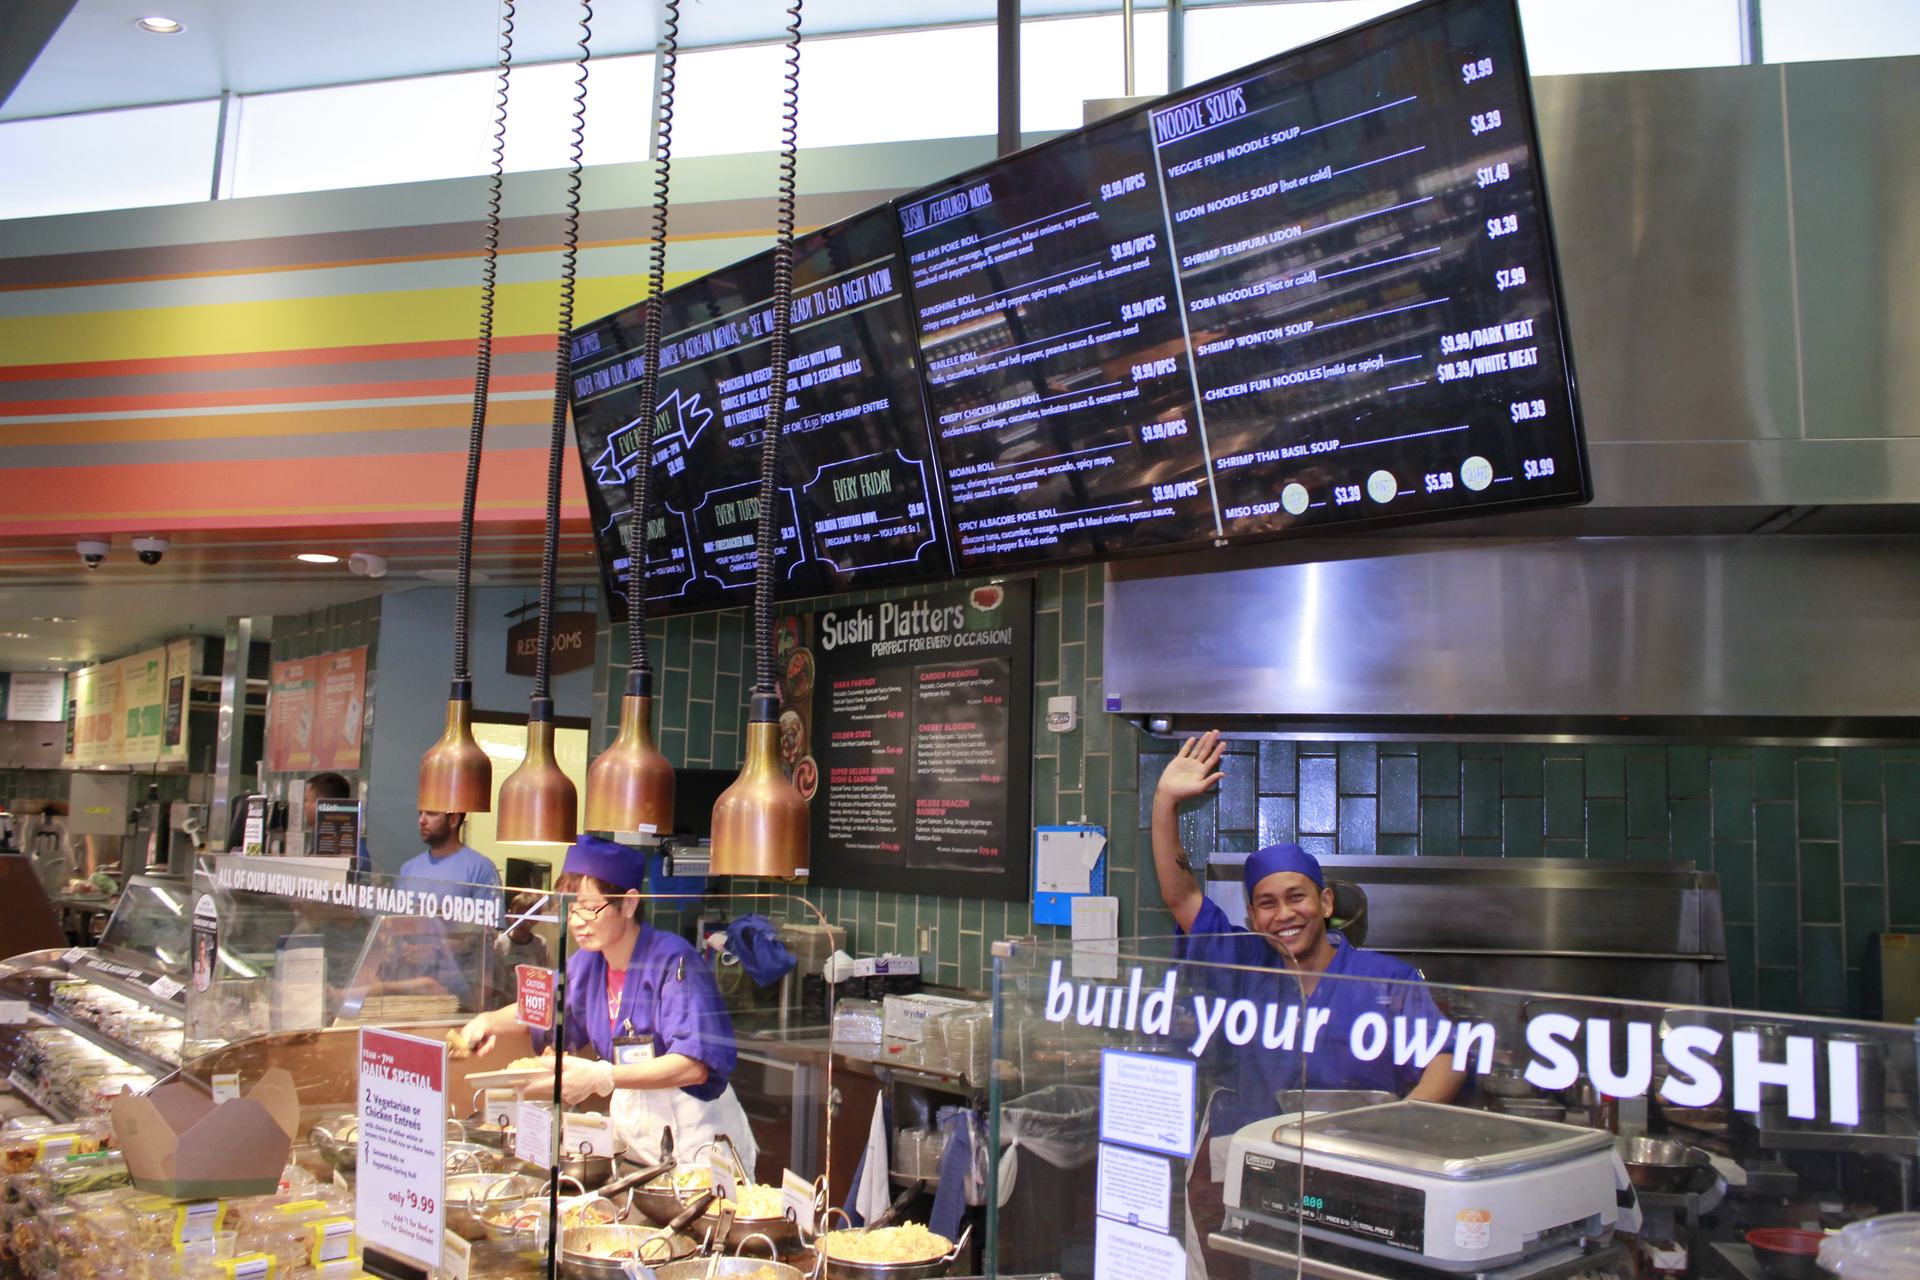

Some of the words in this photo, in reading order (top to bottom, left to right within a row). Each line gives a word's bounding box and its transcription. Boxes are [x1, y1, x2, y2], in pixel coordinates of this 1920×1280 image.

[1154, 98, 1207, 144] NOODLE
[1204, 86, 1247, 126] SOUPS
[1470, 109, 1502, 136] $8.39
[1167, 157, 1203, 178] VEGGIE
[1203, 150, 1226, 167] FUN
[1226, 135, 1271, 160] NOODLE
[1270, 126, 1301, 145] SOUP
[1475, 161, 1510, 189] $11.49
[1174, 204, 1206, 223] UDON
[1206, 191, 1250, 214] NOODLE
[1249, 182, 1279, 201] SOUP
[1278, 178, 1300, 193] [hot
[1298, 175, 1310, 187] or
[1308, 165, 1333, 184] cold]
[900, 204, 927, 235] SUSHI
[968, 183, 993, 209] ROLLS
[1486, 213, 1519, 240] $8.39
[910, 251, 927, 264] FIRE
[926, 247, 941, 260] AHI
[940, 239, 961, 255] POKE
[959, 234, 980, 248] ROLL
[1182, 247, 1221, 268] SHRIMP
[1220, 234, 1269, 257] TEMPURA
[1268, 225, 1303, 244] UDON
[994, 298, 1008, 310] bell
[1030, 288, 1049, 302] spicy
[1096, 269, 1106, 281] &
[1104, 264, 1133, 279] sesame
[1131, 255, 1151, 271] seed
[1189, 296, 1218, 312] SOBA
[1216, 281, 1267, 305] NOODLES
[1264, 276, 1286, 295] [hot
[1284, 278, 1295, 289] or
[1293, 269, 1318, 287] cold]
[1495, 266, 1527, 292] $7.99
[684, 331, 714, 360] KOREAN
[712, 321, 742, 350] MENUS,
[748, 312, 764, 338] SEE
[812, 291, 827, 316] TO
[826, 285, 842, 312] GO
[841, 275, 868, 306] RIGHT
[867, 267, 893, 298] NOW!
[920, 298, 958, 318] SUNSHINE
[957, 293, 977, 307] ROLL
[1087, 334, 1097, 346] &
[1196, 338, 1236, 357] SHRIMP
[1235, 327, 1283, 348] WONTON
[1283, 320, 1314, 337] SOUP
[1503, 318, 1534, 342] MEAT
[808, 350, 826, 367] WITH
[824, 345, 843, 362] YOUR
[929, 355, 960, 372] WAILELE
[958, 351, 979, 364] ROLL
[1436, 352, 1510, 384] $10.39/WHITE
[1507, 346, 1538, 369] MEAT
[800, 373, 814, 389] AND
[817, 364, 843, 384] SESAME
[840, 358, 862, 377] BALLS
[1204, 382, 1249, 401] CHICKEN
[1248, 378, 1272, 393] FUN
[1271, 367, 1324, 388] NOODLES
[1321, 362, 1347, 380] [mild
[1346, 363, 1357, 374] or
[1357, 353, 1385, 374] spicy]
[820, 412, 836, 425] FOR
[834, 405, 863, 421] SHRIMP
[939, 411, 963, 425] CRISPY
[963, 403, 997, 420] CHICKEN
[996, 397, 1022, 412] KATSU
[1019, 393, 1042, 407] ROLL
[1067, 399, 1089, 411] sauce
[1087, 395, 1097, 407] &
[1094, 392, 1123, 405] sesame
[1510, 399, 1547, 423] $10.39
[1216, 453, 1255, 470] SHRIMP
[1254, 449, 1280, 463] THAI
[1279, 444, 1311, 459] BASIL
[1309, 439, 1341, 455] SOUP
[948, 465, 977, 478] MOANA
[976, 461, 997, 473] ROLL
[832, 475, 858, 503] EVERY
[859, 468, 892, 497] FRIDAY
[714, 501, 737, 527] EVERY
[1225, 505, 1252, 519] MISO
[1251, 501, 1281, 516] SOUP
[1333, 484, 1362, 506] $3.39
[958, 520, 978, 532] SPICY
[978, 514, 1017, 529] ALBACORE
[1016, 510, 1038, 523] POKE
[1037, 508, 1058, 520] ROLL
[1077, 517, 1087, 529] &
[1128, 510, 1153, 523] ponzu
[1150, 507, 1176, 518] sauce,
[1016, 538, 1025, 548] &
[822, 608, 873, 650] Sushi
[880, 600, 964, 641] Platters
[517, 631, 581, 656] RESOOMS
[872, 639, 909, 657] PERFECT
[909, 638, 925, 651] FOR
[926, 635, 952, 650] EVERY
[954, 627, 1012, 647] OCCASION!
[920, 672, 946, 681] GARDEN
[947, 669, 978, 679] PARADISE
[855, 730, 872, 738] STATE
[918, 724, 943, 732] CHERRY
[944, 722, 976, 731] BLOSSOM
[916, 808, 946, 816] RAINBOW
[942, 800, 970, 808] DRAGON
[218, 868, 232, 889] ALL
[234, 870, 246, 890] OF
[247, 871, 266, 892] OUR
[267, 872, 297, 898] MENU
[297, 877, 329, 902] ITEMS
[333, 883, 357, 908] CAN
[359, 886, 374, 909] BE
[376, 889, 414, 915] MADE
[417, 892, 437, 919] TO
[442, 895, 500, 929] ORDER!
[525, 995, 545, 1011] HOT!
[1045, 960, 1177, 1036] build
[1192, 996, 1330, 1058] your
[1349, 1011, 1495, 1075] own
[1524, 1013, 1860, 1126] SUSHI
[362, 1061, 390, 1079] DAILY
[392, 1067, 432, 1090] SPECIAL
[365, 1105, 393, 1122] Chicken
[366, 1088, 371, 1103] 2
[374, 1093, 411, 1114] Vegetarian
[413, 1107, 421, 1116] or
[393, 1166, 407, 1178] Spring
[388, 1191, 405, 1208] only
[407, 1189, 434, 1214] $9.99
[1359, 1222, 1374, 1232] TOTAL
[1375, 1225, 1390, 1236] PRICE
